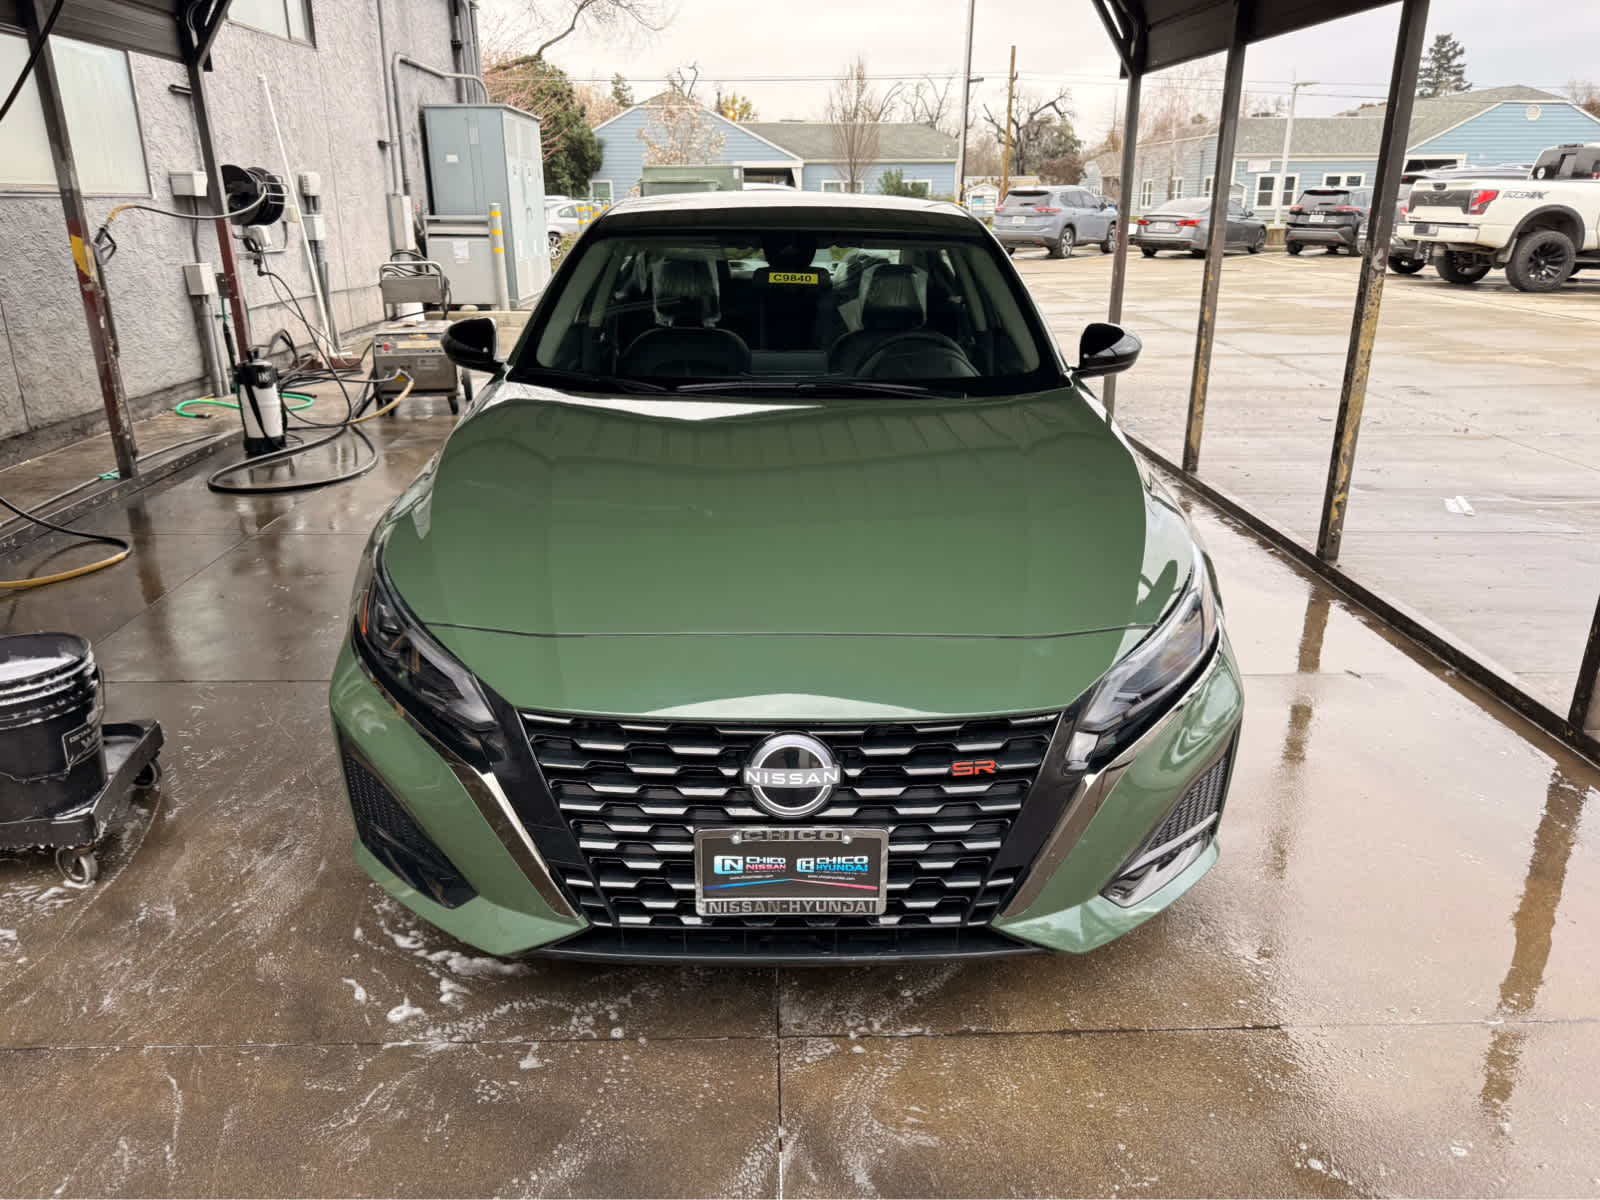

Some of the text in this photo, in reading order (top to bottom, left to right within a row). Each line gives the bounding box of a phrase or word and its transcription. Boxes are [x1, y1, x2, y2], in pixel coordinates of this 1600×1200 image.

[773, 274, 812, 282] C9840
[952, 760, 996, 776] SR
[746, 770, 838, 785] NISSAN
[744, 831, 840, 840] CHICO
[745, 856, 786, 864] CHICO
[816, 856, 869, 864] CHICO
[816, 864, 869, 872] HYUNDAI
[709, 901, 873, 913] NISSAN-HYUNDAI
